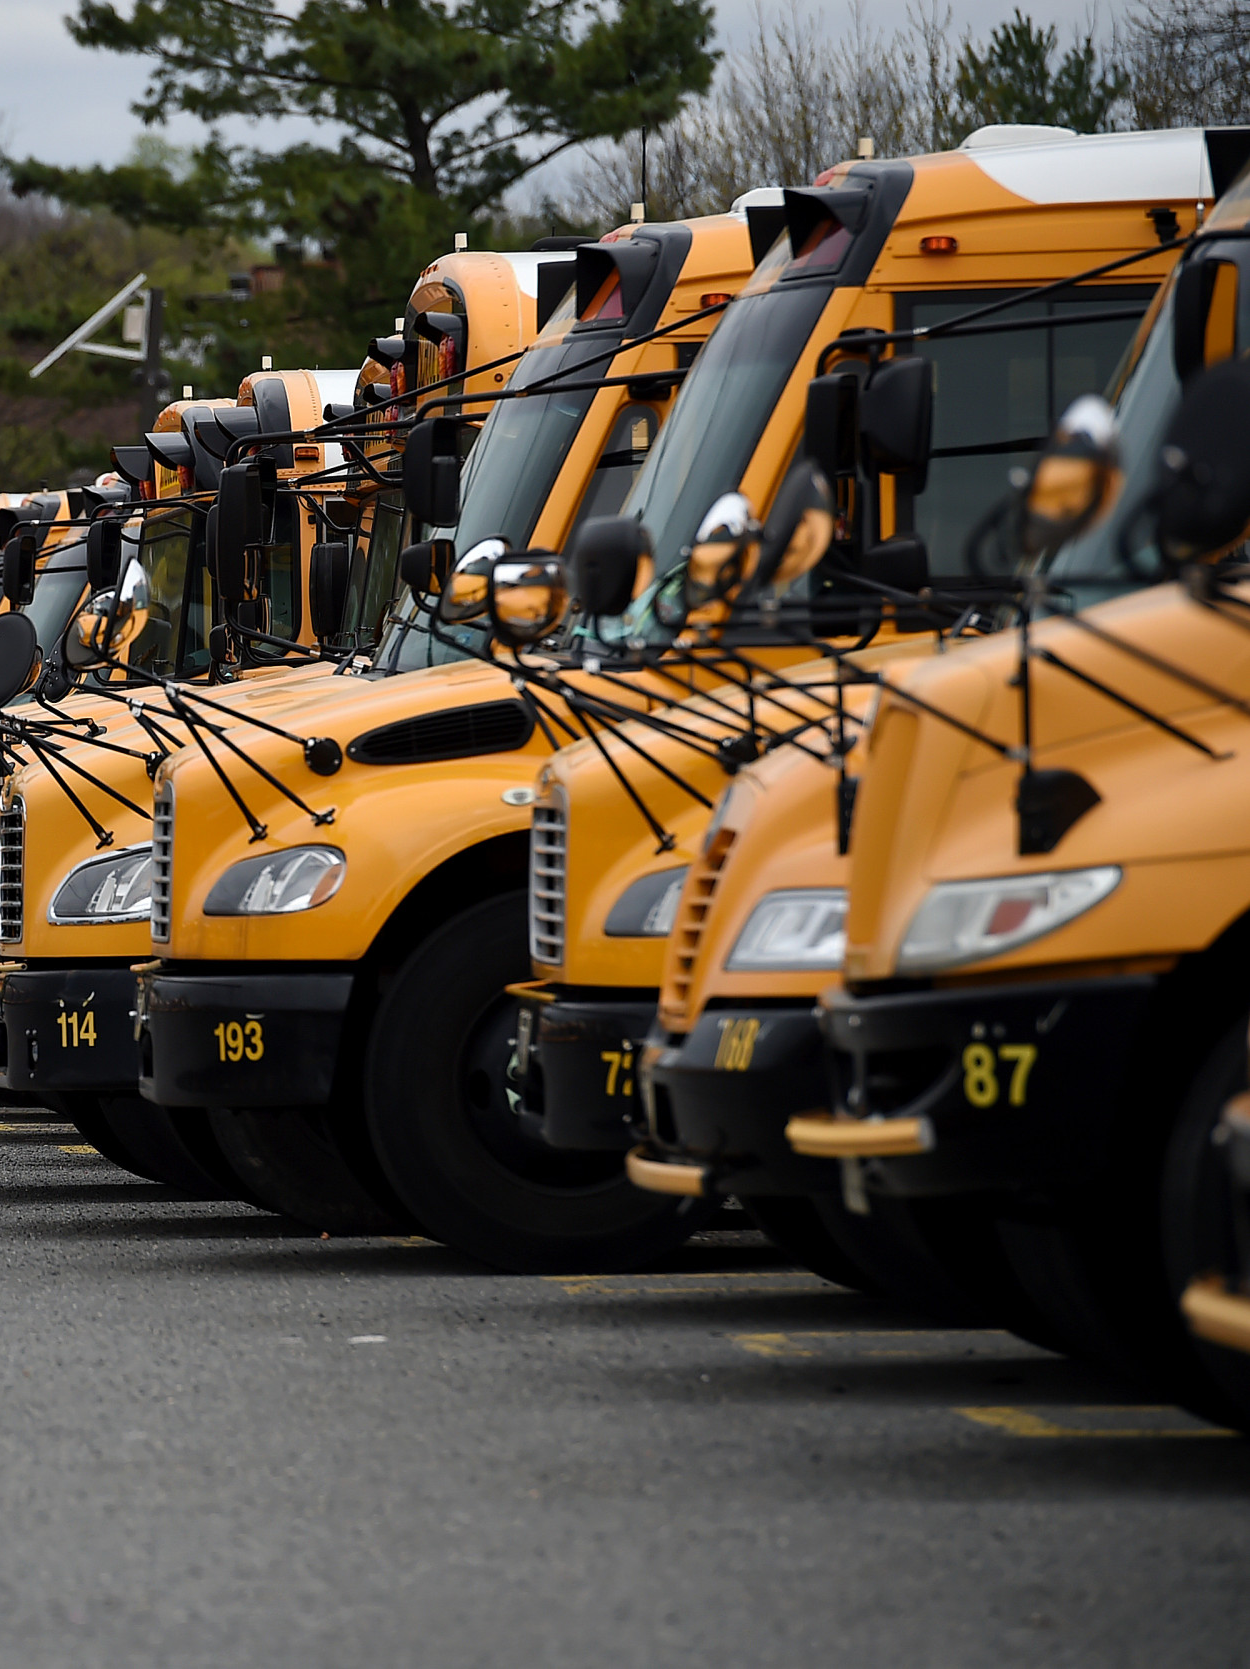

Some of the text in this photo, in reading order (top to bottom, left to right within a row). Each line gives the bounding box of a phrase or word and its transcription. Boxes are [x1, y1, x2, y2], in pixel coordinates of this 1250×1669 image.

[57, 1011, 97, 1047] 114
[214, 1020, 264, 1062] 193
[962, 1042, 1038, 1108] 87
